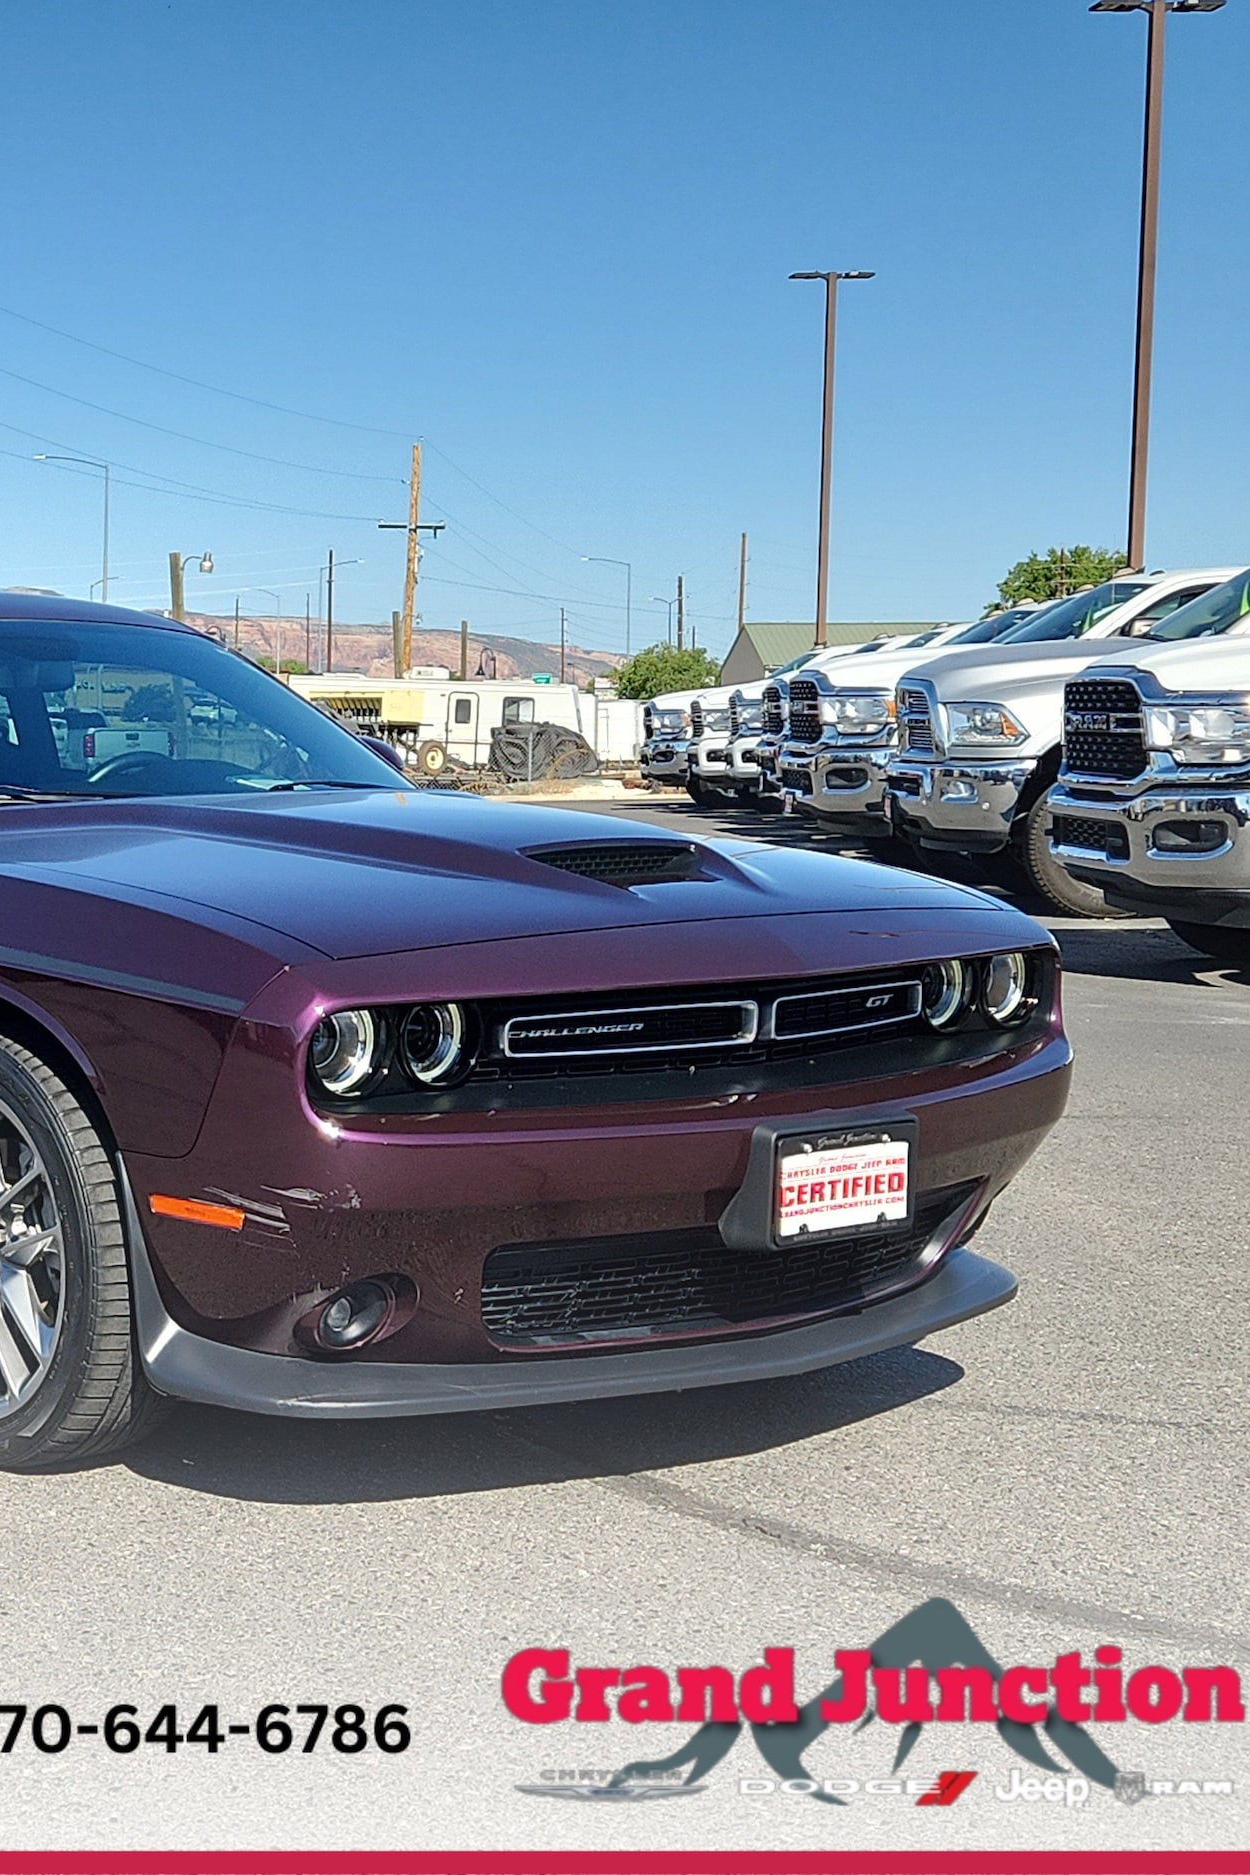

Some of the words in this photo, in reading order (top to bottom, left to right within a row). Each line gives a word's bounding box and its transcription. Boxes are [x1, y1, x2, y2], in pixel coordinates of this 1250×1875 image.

[1071, 714, 1107, 730] RAM
[865, 993, 895, 1008] GT
[509, 1023, 645, 1039] CHALLENGER
[830, 1163, 858, 1173] DODGE
[861, 1159, 882, 1169] JEEP
[885, 1157, 906, 1166] RAM
[779, 1172, 905, 1208] CERTIFIED
